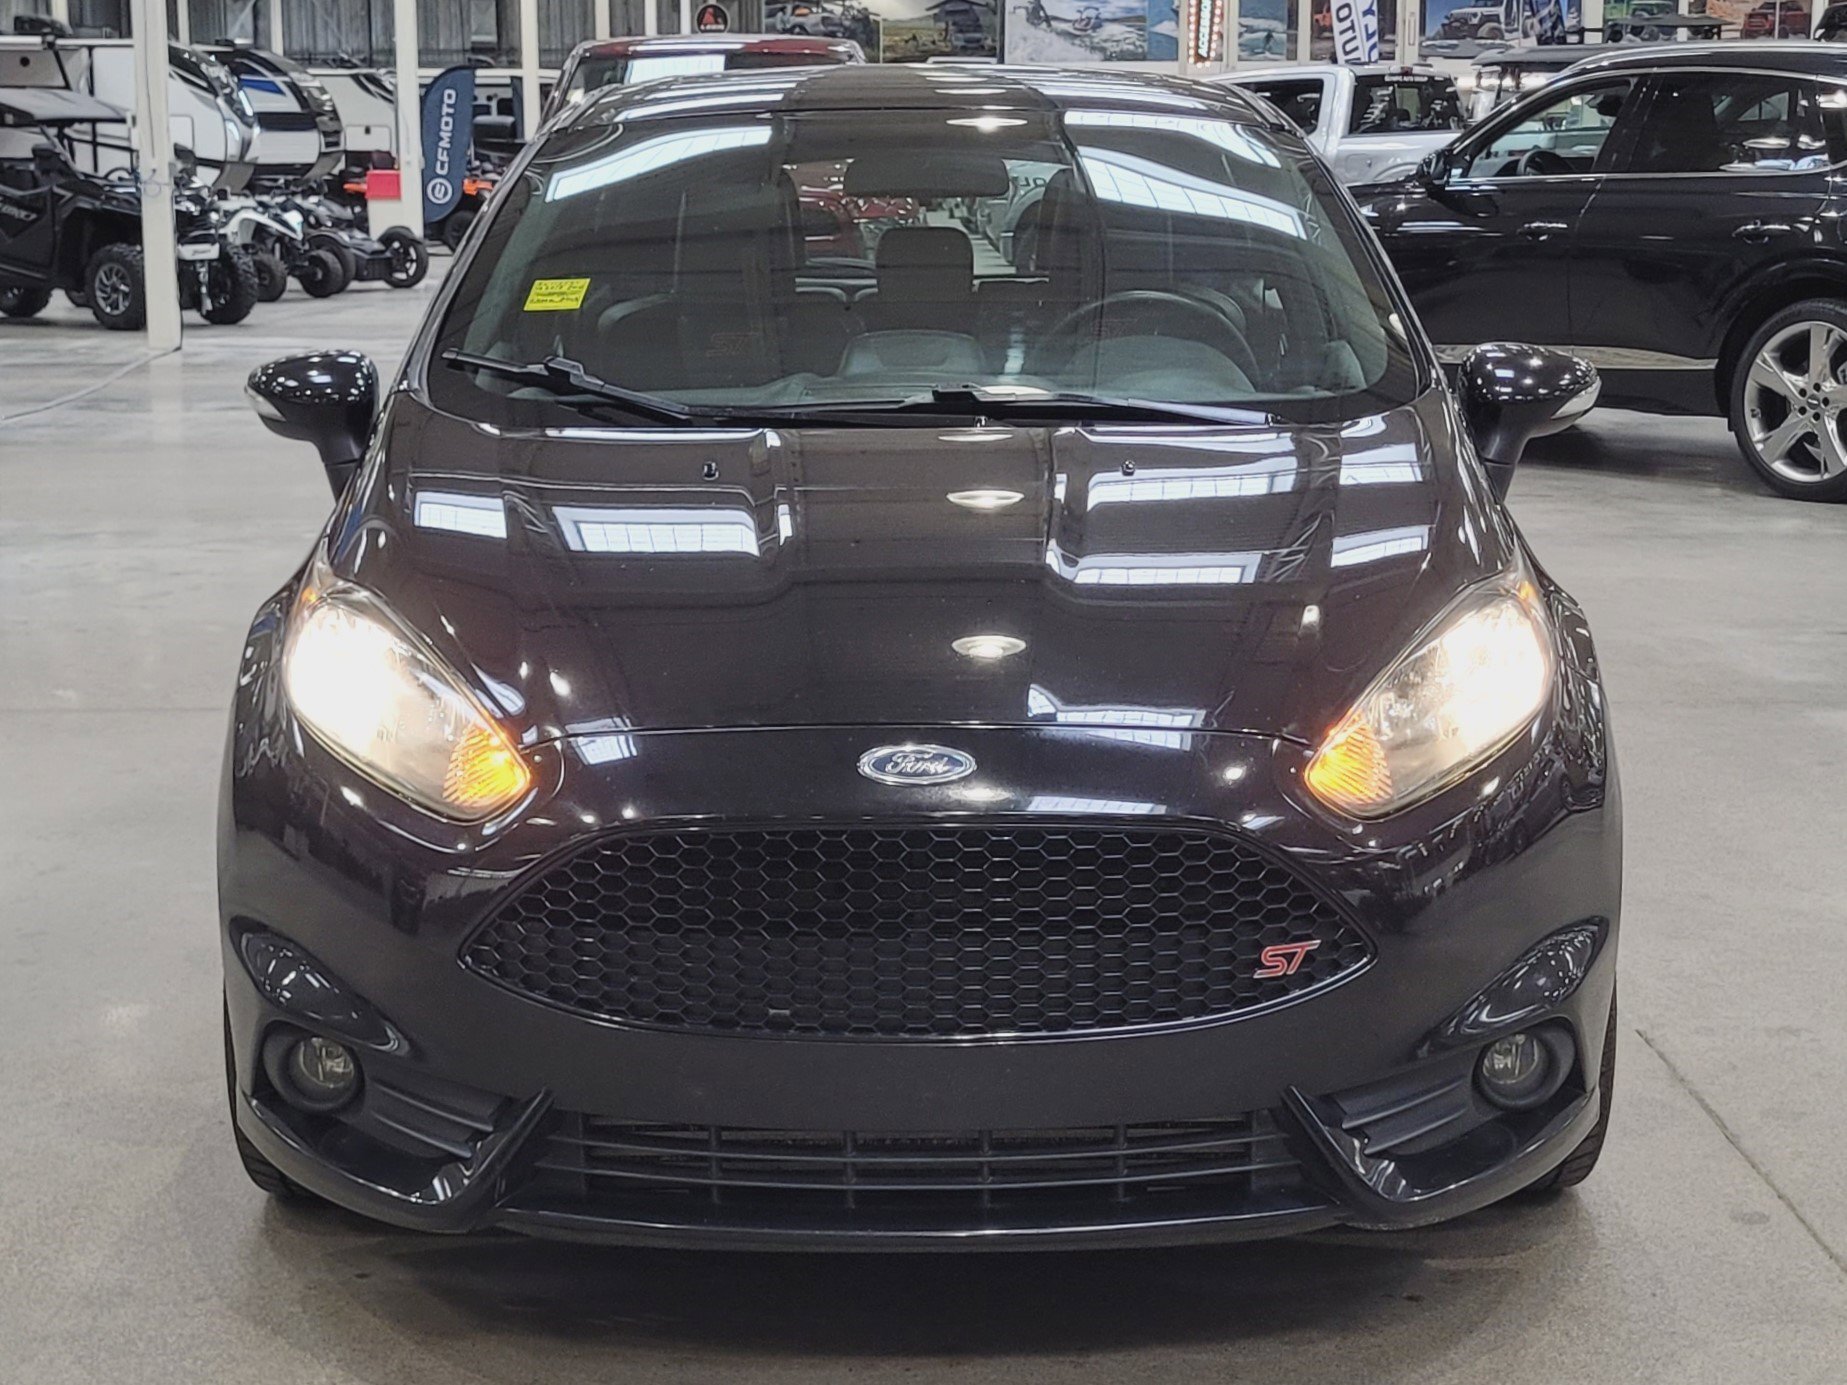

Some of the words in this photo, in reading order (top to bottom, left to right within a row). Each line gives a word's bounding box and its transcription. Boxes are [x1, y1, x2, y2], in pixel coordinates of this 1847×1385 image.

[435, 88, 457, 176] CFMOTO
[884, 749, 951, 774] Ford
[1252, 939, 1322, 979] ST
